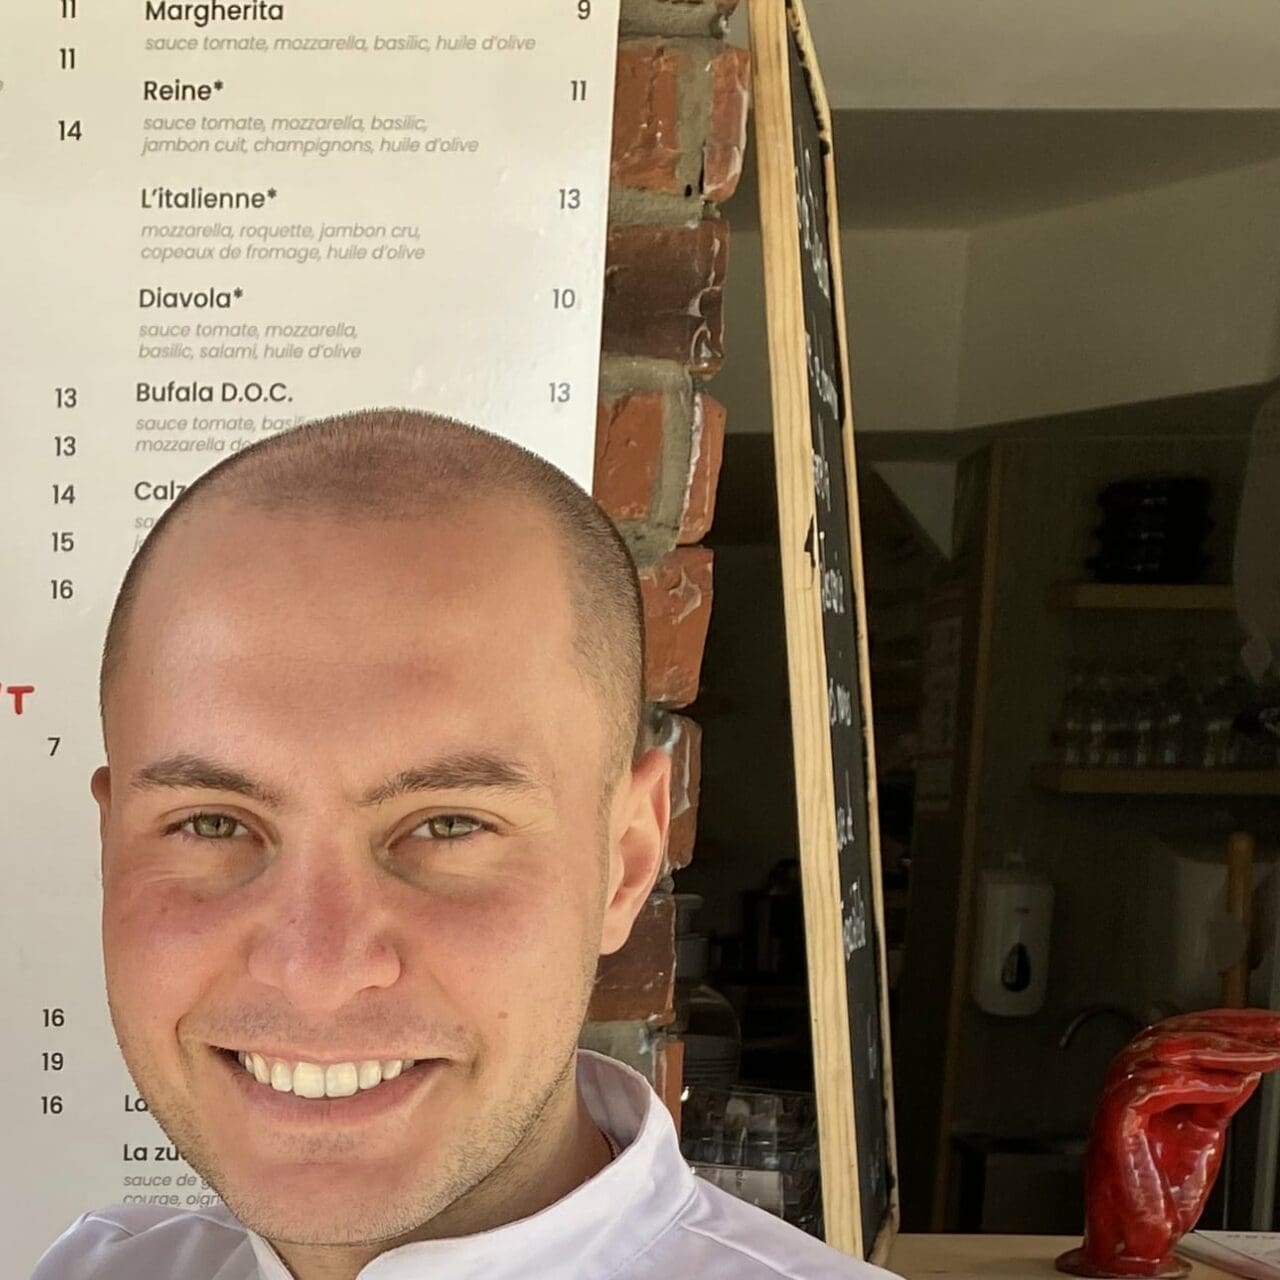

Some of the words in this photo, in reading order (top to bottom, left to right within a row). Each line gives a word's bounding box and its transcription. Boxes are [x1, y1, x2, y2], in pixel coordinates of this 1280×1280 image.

[62, 0, 75, 18] 11
[146, 0, 283, 27] Margherita
[578, 0, 590, 20] 9
[145, 38, 198, 50] sauce
[203, 36, 268, 52] tomate,
[273, 35, 368, 52] mozzarella,
[374, 35, 431, 52] basilic,
[435, 35, 477, 50] huile
[481, 35, 536, 50] d'olive
[60, 48, 74, 69] 11
[571, 81, 586, 101] 11
[59, 121, 82, 140] 14
[144, 118, 197, 130] sauce
[201, 116, 265, 132] tomate,
[271, 115, 365, 133] mozzarella,
[370, 115, 427, 132] basilic,
[141, 137, 209, 156] jambon
[214, 136, 248, 154] cuit,
[254, 136, 374, 157] champignons,
[379, 136, 421, 152] huile
[425, 137, 479, 152] d'olive
[560, 189, 580, 209] 13
[141, 222, 234, 240] mozzarella,
[239, 224, 314, 242] roquette,
[317, 223, 386, 243] jambon
[391, 226, 420, 241] cru,
[141, 247, 215, 264] copeaux
[219, 244, 241, 260] de
[246, 244, 321, 263] fromage,
[326, 244, 367, 260] huile
[371, 244, 425, 260] d'olive
[553, 289, 575, 309] 10
[139, 325, 191, 338] sauce
[196, 323, 259, 340] tomate,
[265, 322, 357, 339] mozzarella,
[138, 343, 194, 360] basilic,
[199, 342, 258, 360] salami,
[264, 343, 304, 359] huile
[56, 388, 76, 408] 13
[137, 381, 213, 402] Bufala
[222, 383, 292, 402] D.O.C.
[549, 383, 570, 403] 13
[136, 419, 188, 431] sauce
[192, 416, 256, 432] tomate,
[55, 436, 75, 456] 13
[136, 437, 225, 452] mozzarella
[53, 485, 75, 504] 14
[52, 532, 74, 552] 15
[51, 580, 73, 599] 16
[48, 737, 60, 756] 7
[43, 1009, 64, 1027] 16
[42, 1053, 63, 1071] 19
[42, 1096, 62, 1114] 16
[124, 1144, 147, 1161] La
[123, 1175, 172, 1187] sauce
[176, 1174, 197, 1187] de
